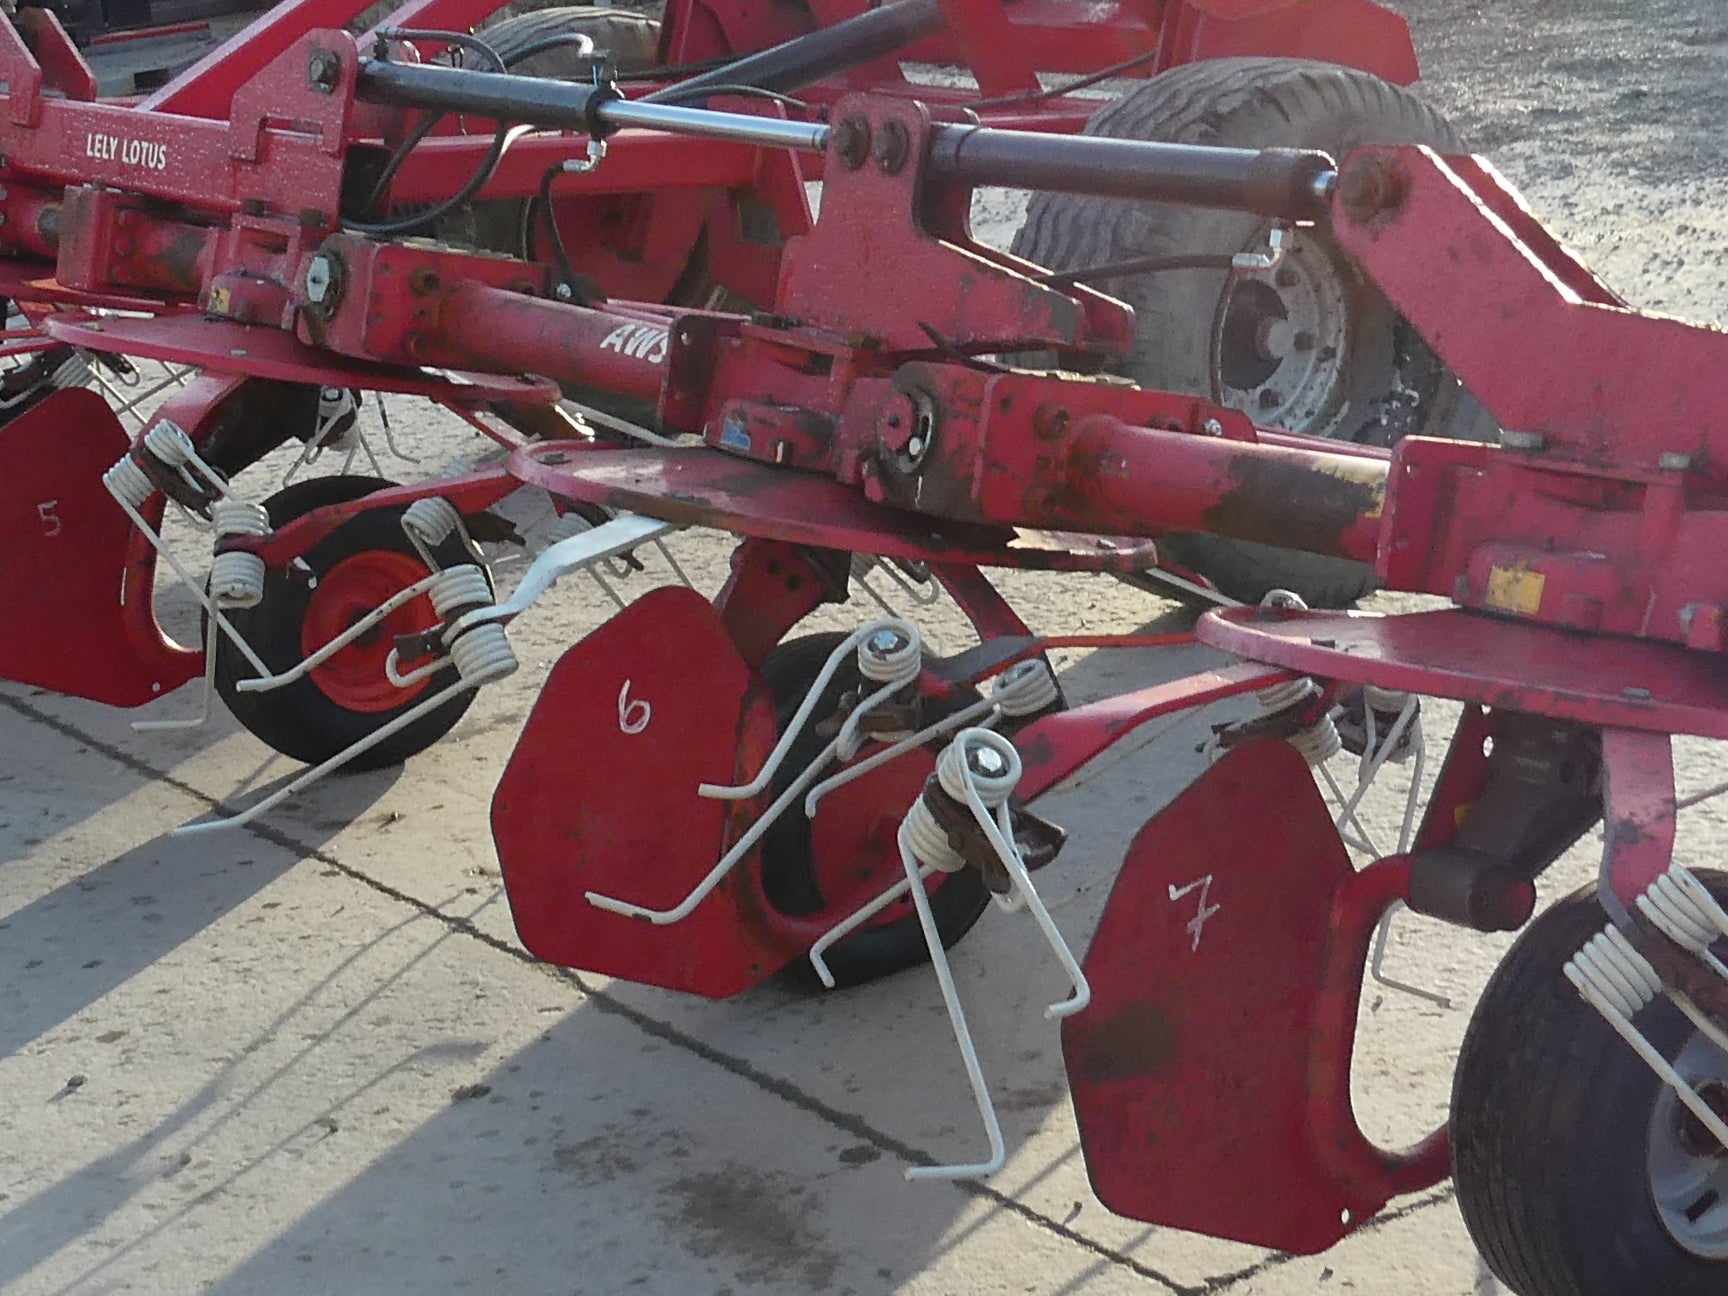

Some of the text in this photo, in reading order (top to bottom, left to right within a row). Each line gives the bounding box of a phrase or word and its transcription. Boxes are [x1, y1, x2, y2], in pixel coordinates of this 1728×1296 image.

[86, 133, 167, 170] LELY LOTUS
[599, 324, 669, 364] AWS
[36, 499, 62, 537] 5
[618, 678, 652, 735] 6
[1168, 873, 1221, 953] 7
